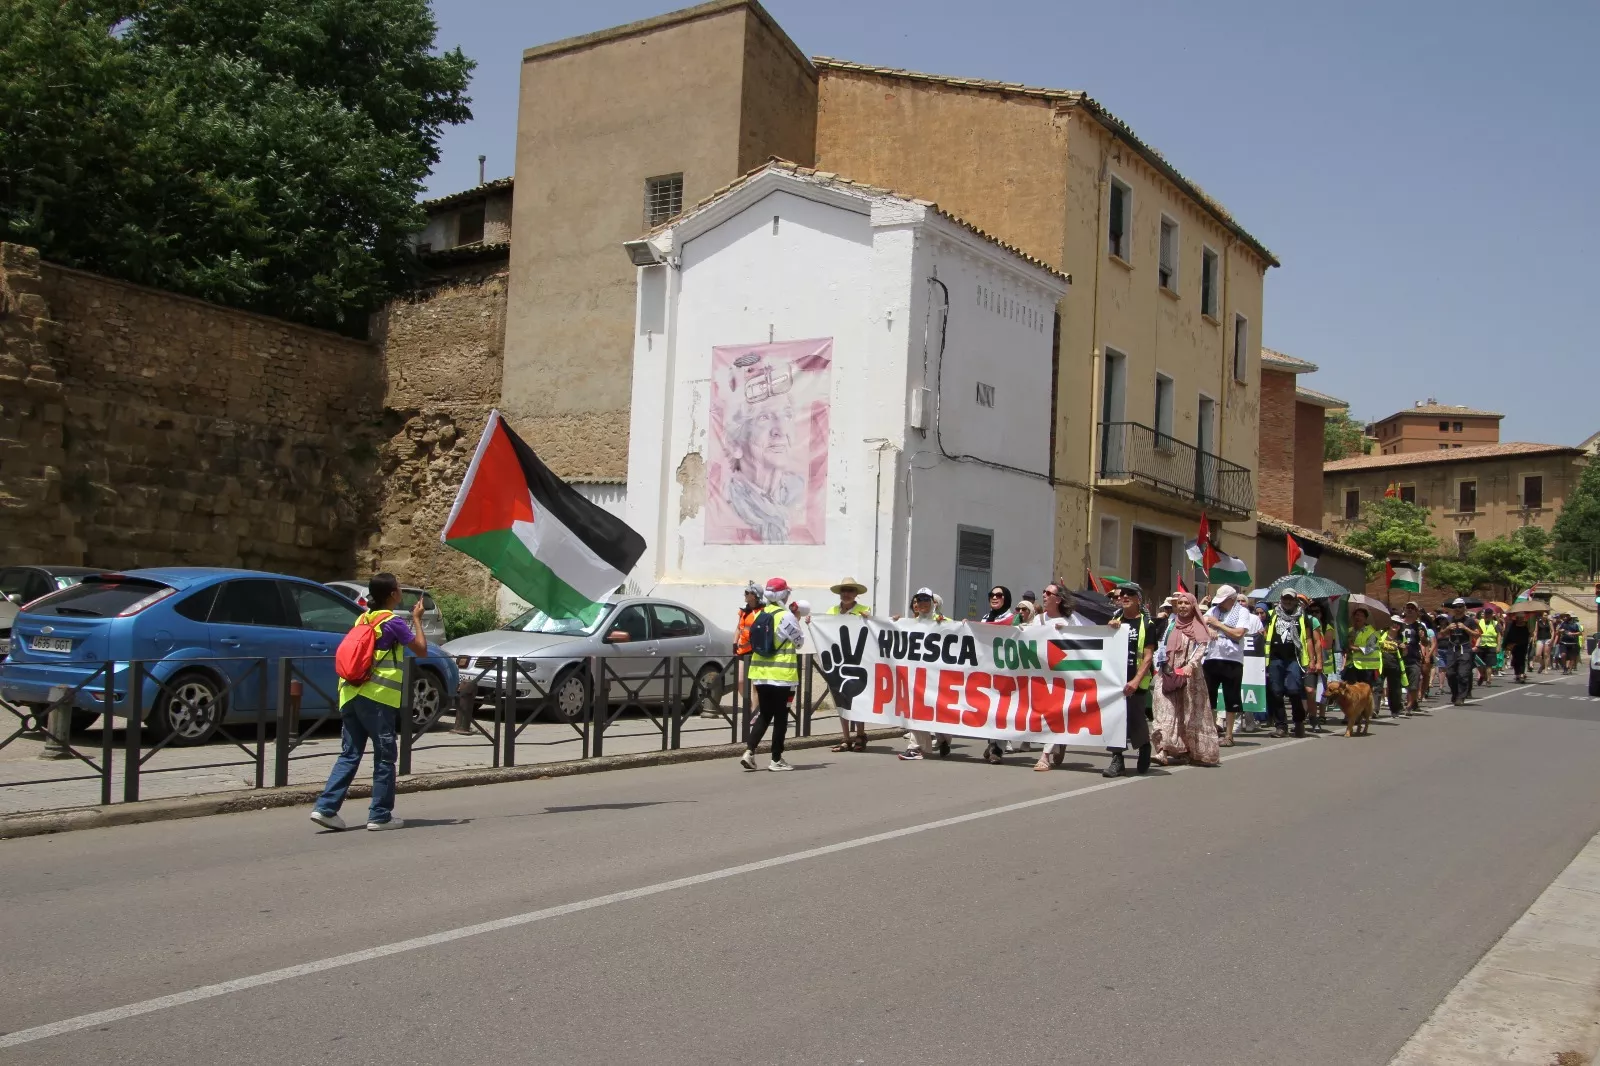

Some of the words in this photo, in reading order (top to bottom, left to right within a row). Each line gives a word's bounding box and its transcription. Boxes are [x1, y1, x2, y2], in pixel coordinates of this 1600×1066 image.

[33, 636, 50, 649] 4635
[54, 639, 70, 651] GGT
[878, 629, 978, 667] HUESCA
[993, 636, 1041, 670] CON
[873, 663, 1103, 736] PALESTINA
